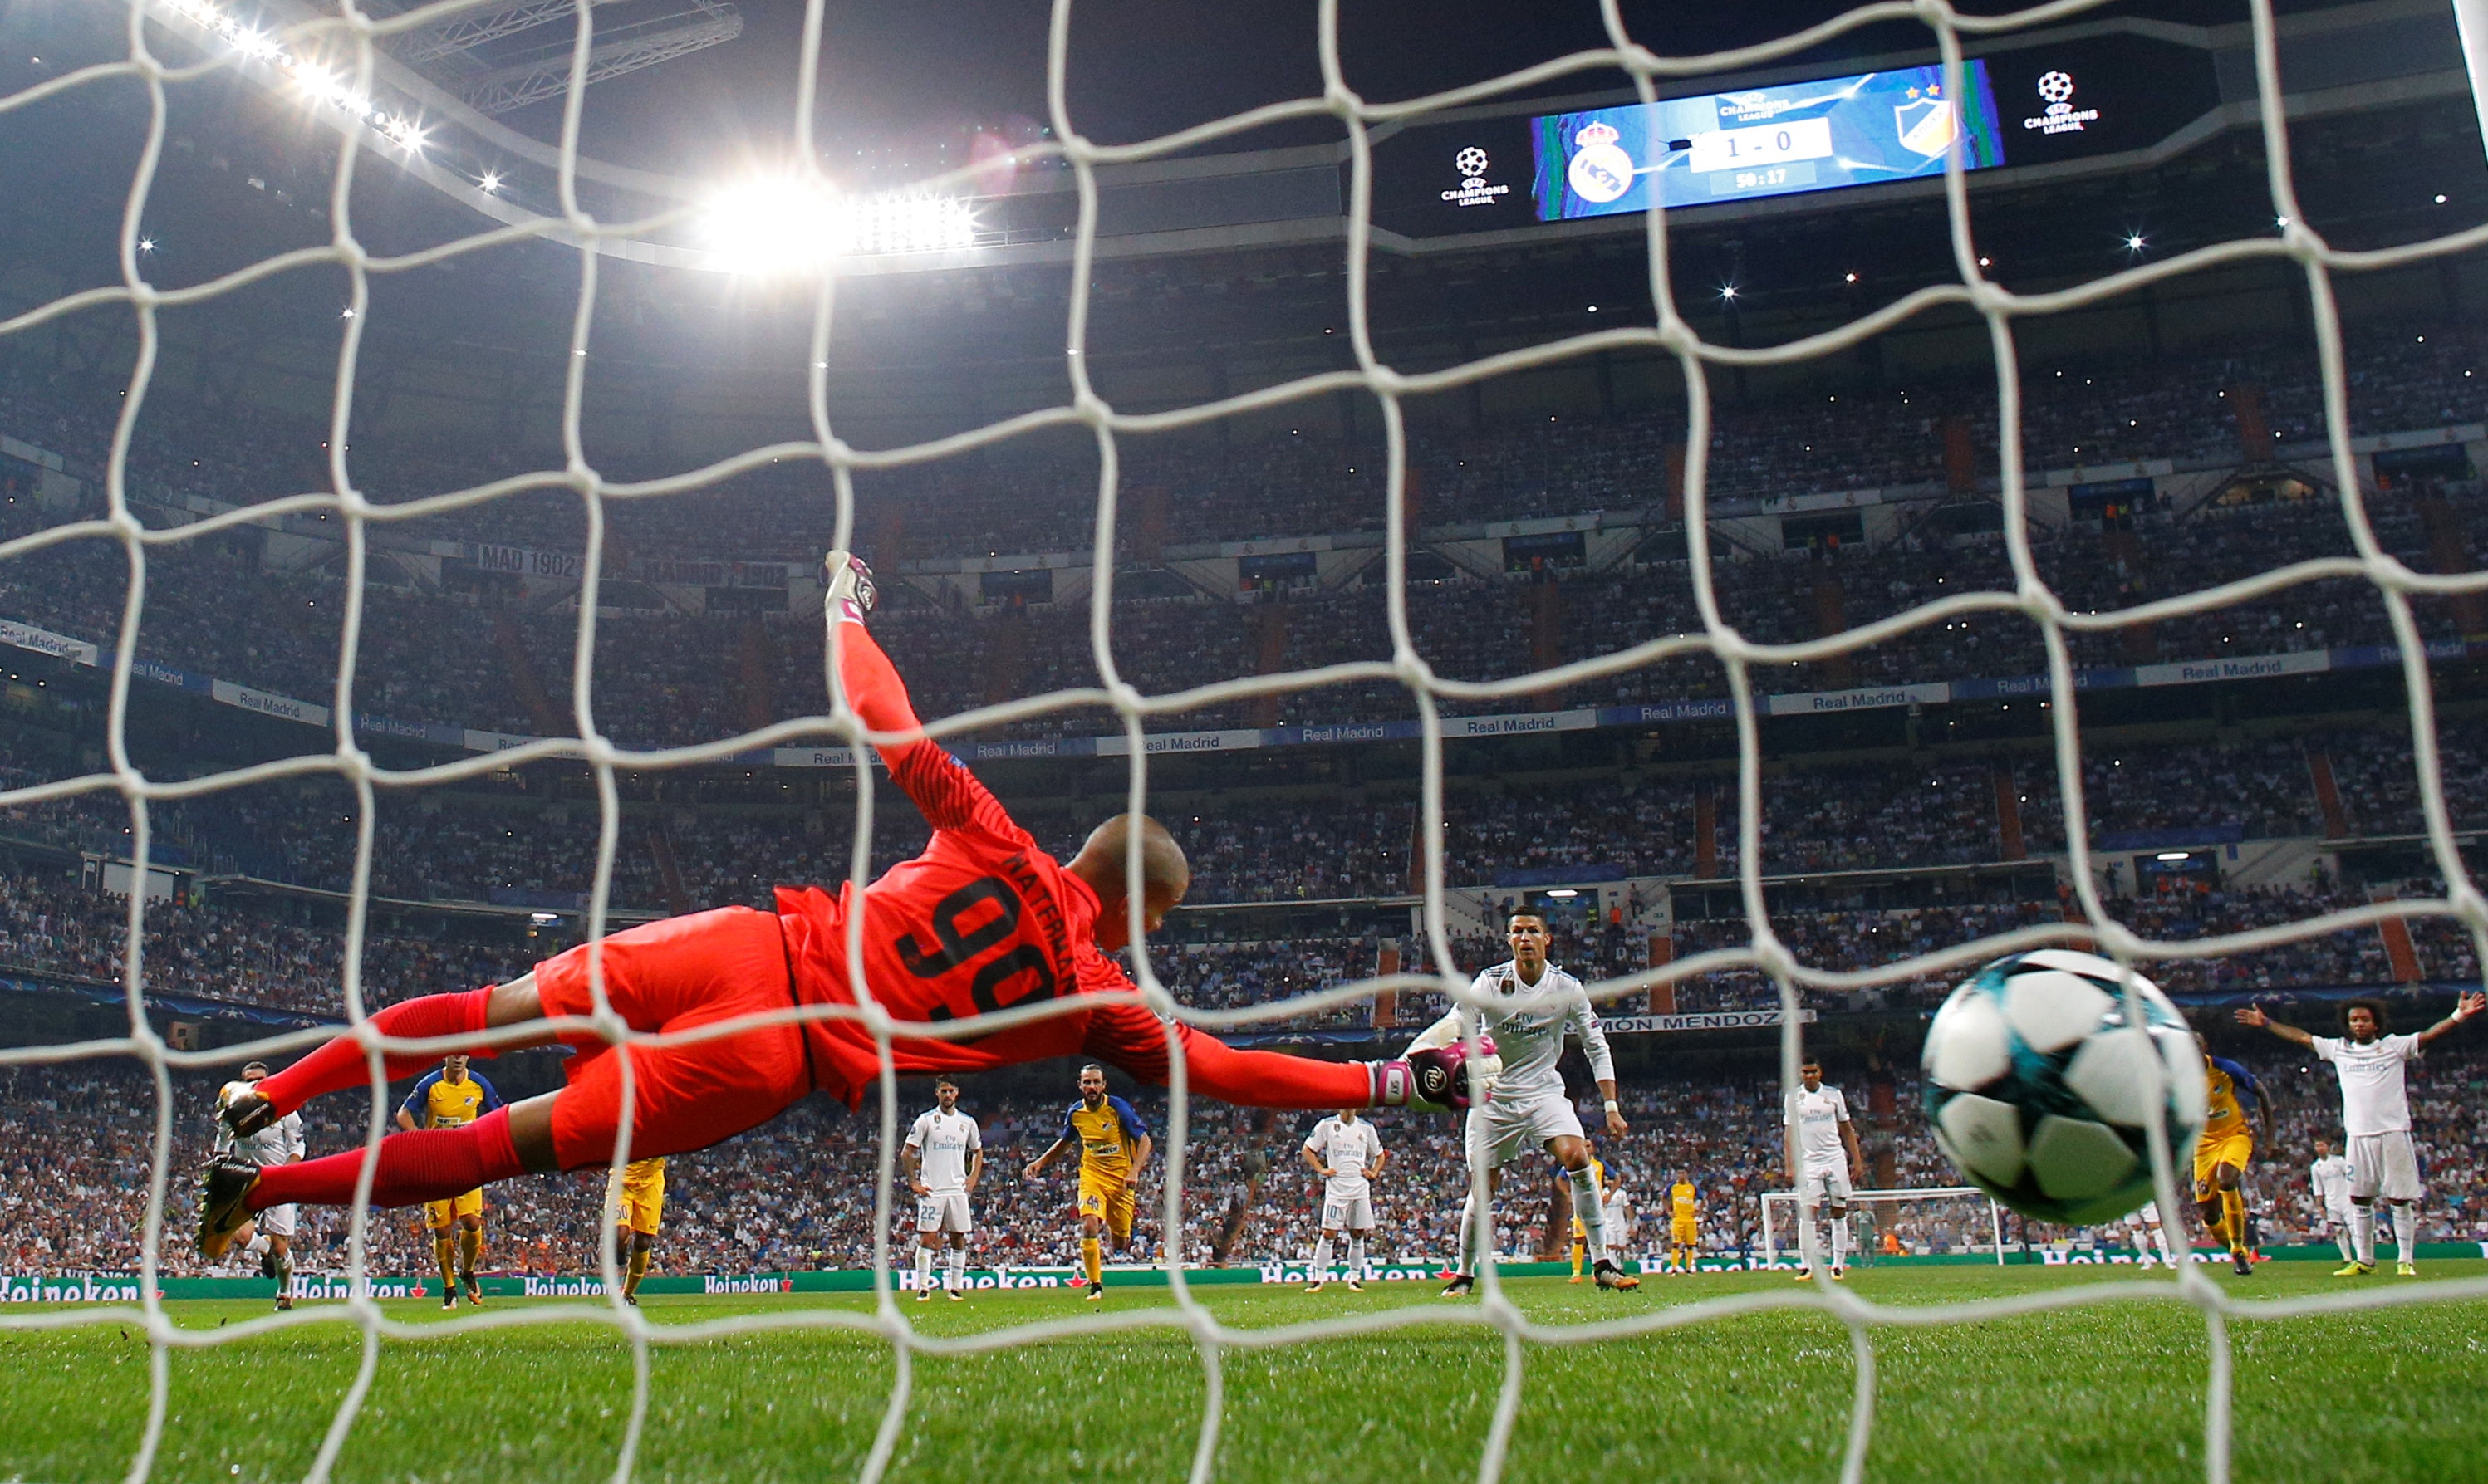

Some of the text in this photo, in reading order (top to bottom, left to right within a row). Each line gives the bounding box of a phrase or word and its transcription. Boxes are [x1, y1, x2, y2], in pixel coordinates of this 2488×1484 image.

[2024, 109, 2099, 129] CHAMPIONS
[2044, 122, 2082, 134] LEAGUE
[1727, 138, 1740, 157] 1
[1776, 130, 1791, 151] 0
[1736, 169, 1786, 188] 50:17
[1441, 184, 1509, 200] CHAMPIONS
[1459, 196, 1494, 207] LEAGUE
[531, 551, 575, 577] 1902
[0, 625, 25, 644] Real
[133, 663, 147, 676] eal
[2183, 660, 2282, 679] Real Madrid
[1997, 680, 2031, 693] Real
[240, 693, 261, 708] Real
[1813, 691, 1905, 709] Real Madrid
[1641, 703, 1726, 720] Real Madrid
[361, 718, 385, 732] Real
[1467, 718, 1554, 734] Real Madrid
[1303, 726, 1384, 742] Real Madrid
[978, 742, 1056, 757] Real Madrid
[1146, 737, 1219, 752] eal Madrid
[814, 752, 843, 765] Real
[895, 876, 1055, 1045] 99
[1663, 1012, 1783, 1030] MENDOZ
[933, 1142, 964, 1151] Emirates
[920, 1206, 935, 1221] 22
[1326, 1205, 1337, 1218] 10
[704, 1272, 778, 1294] Heineken
